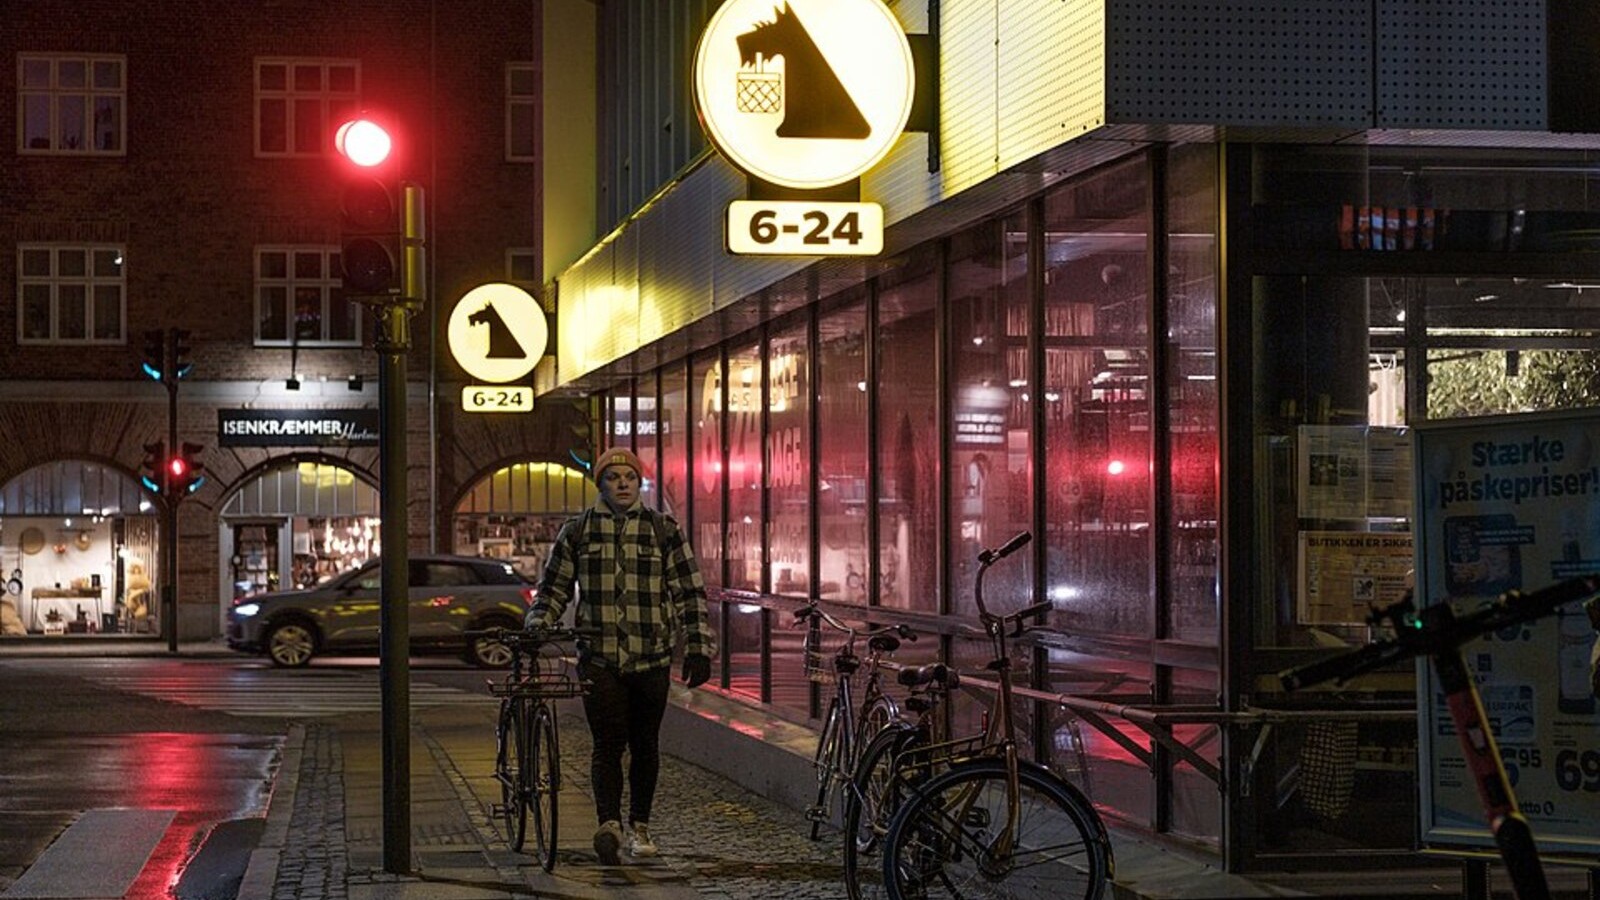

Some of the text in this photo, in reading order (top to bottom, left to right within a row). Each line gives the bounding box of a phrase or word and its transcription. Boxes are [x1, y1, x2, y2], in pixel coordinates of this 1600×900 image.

[749, 210, 863, 245] 6-24
[472, 391, 524, 407] 6-24
[223, 420, 342, 435] ISENKRÆMMER
[766, 427, 802, 488] DAGE
[1472, 435, 1564, 467] Stærke
[1439, 465, 1599, 508] påskepriser!
[1308, 538, 1363, 547] BUTIKKEN
[1366, 538, 1381, 547] ER
[1519, 749, 1542, 767] 95
